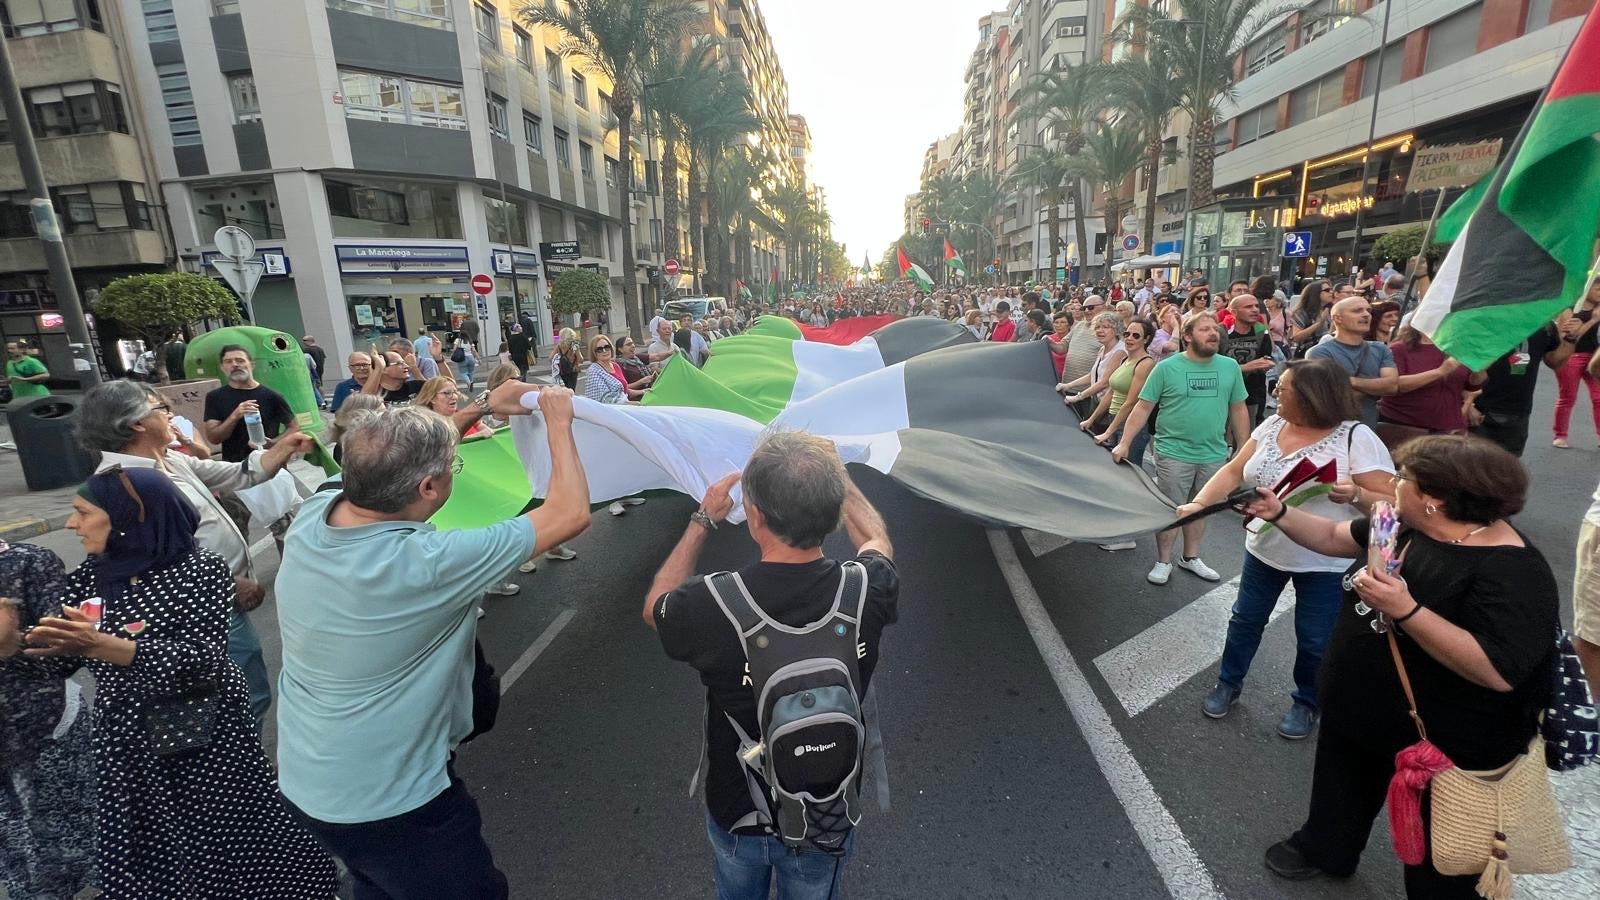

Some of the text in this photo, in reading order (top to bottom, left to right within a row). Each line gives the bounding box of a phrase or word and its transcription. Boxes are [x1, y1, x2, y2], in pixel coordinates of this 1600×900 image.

[1416, 151, 1450, 167] TIERRA
[355, 248, 366, 256] La
[368, 248, 411, 258] Manchega
